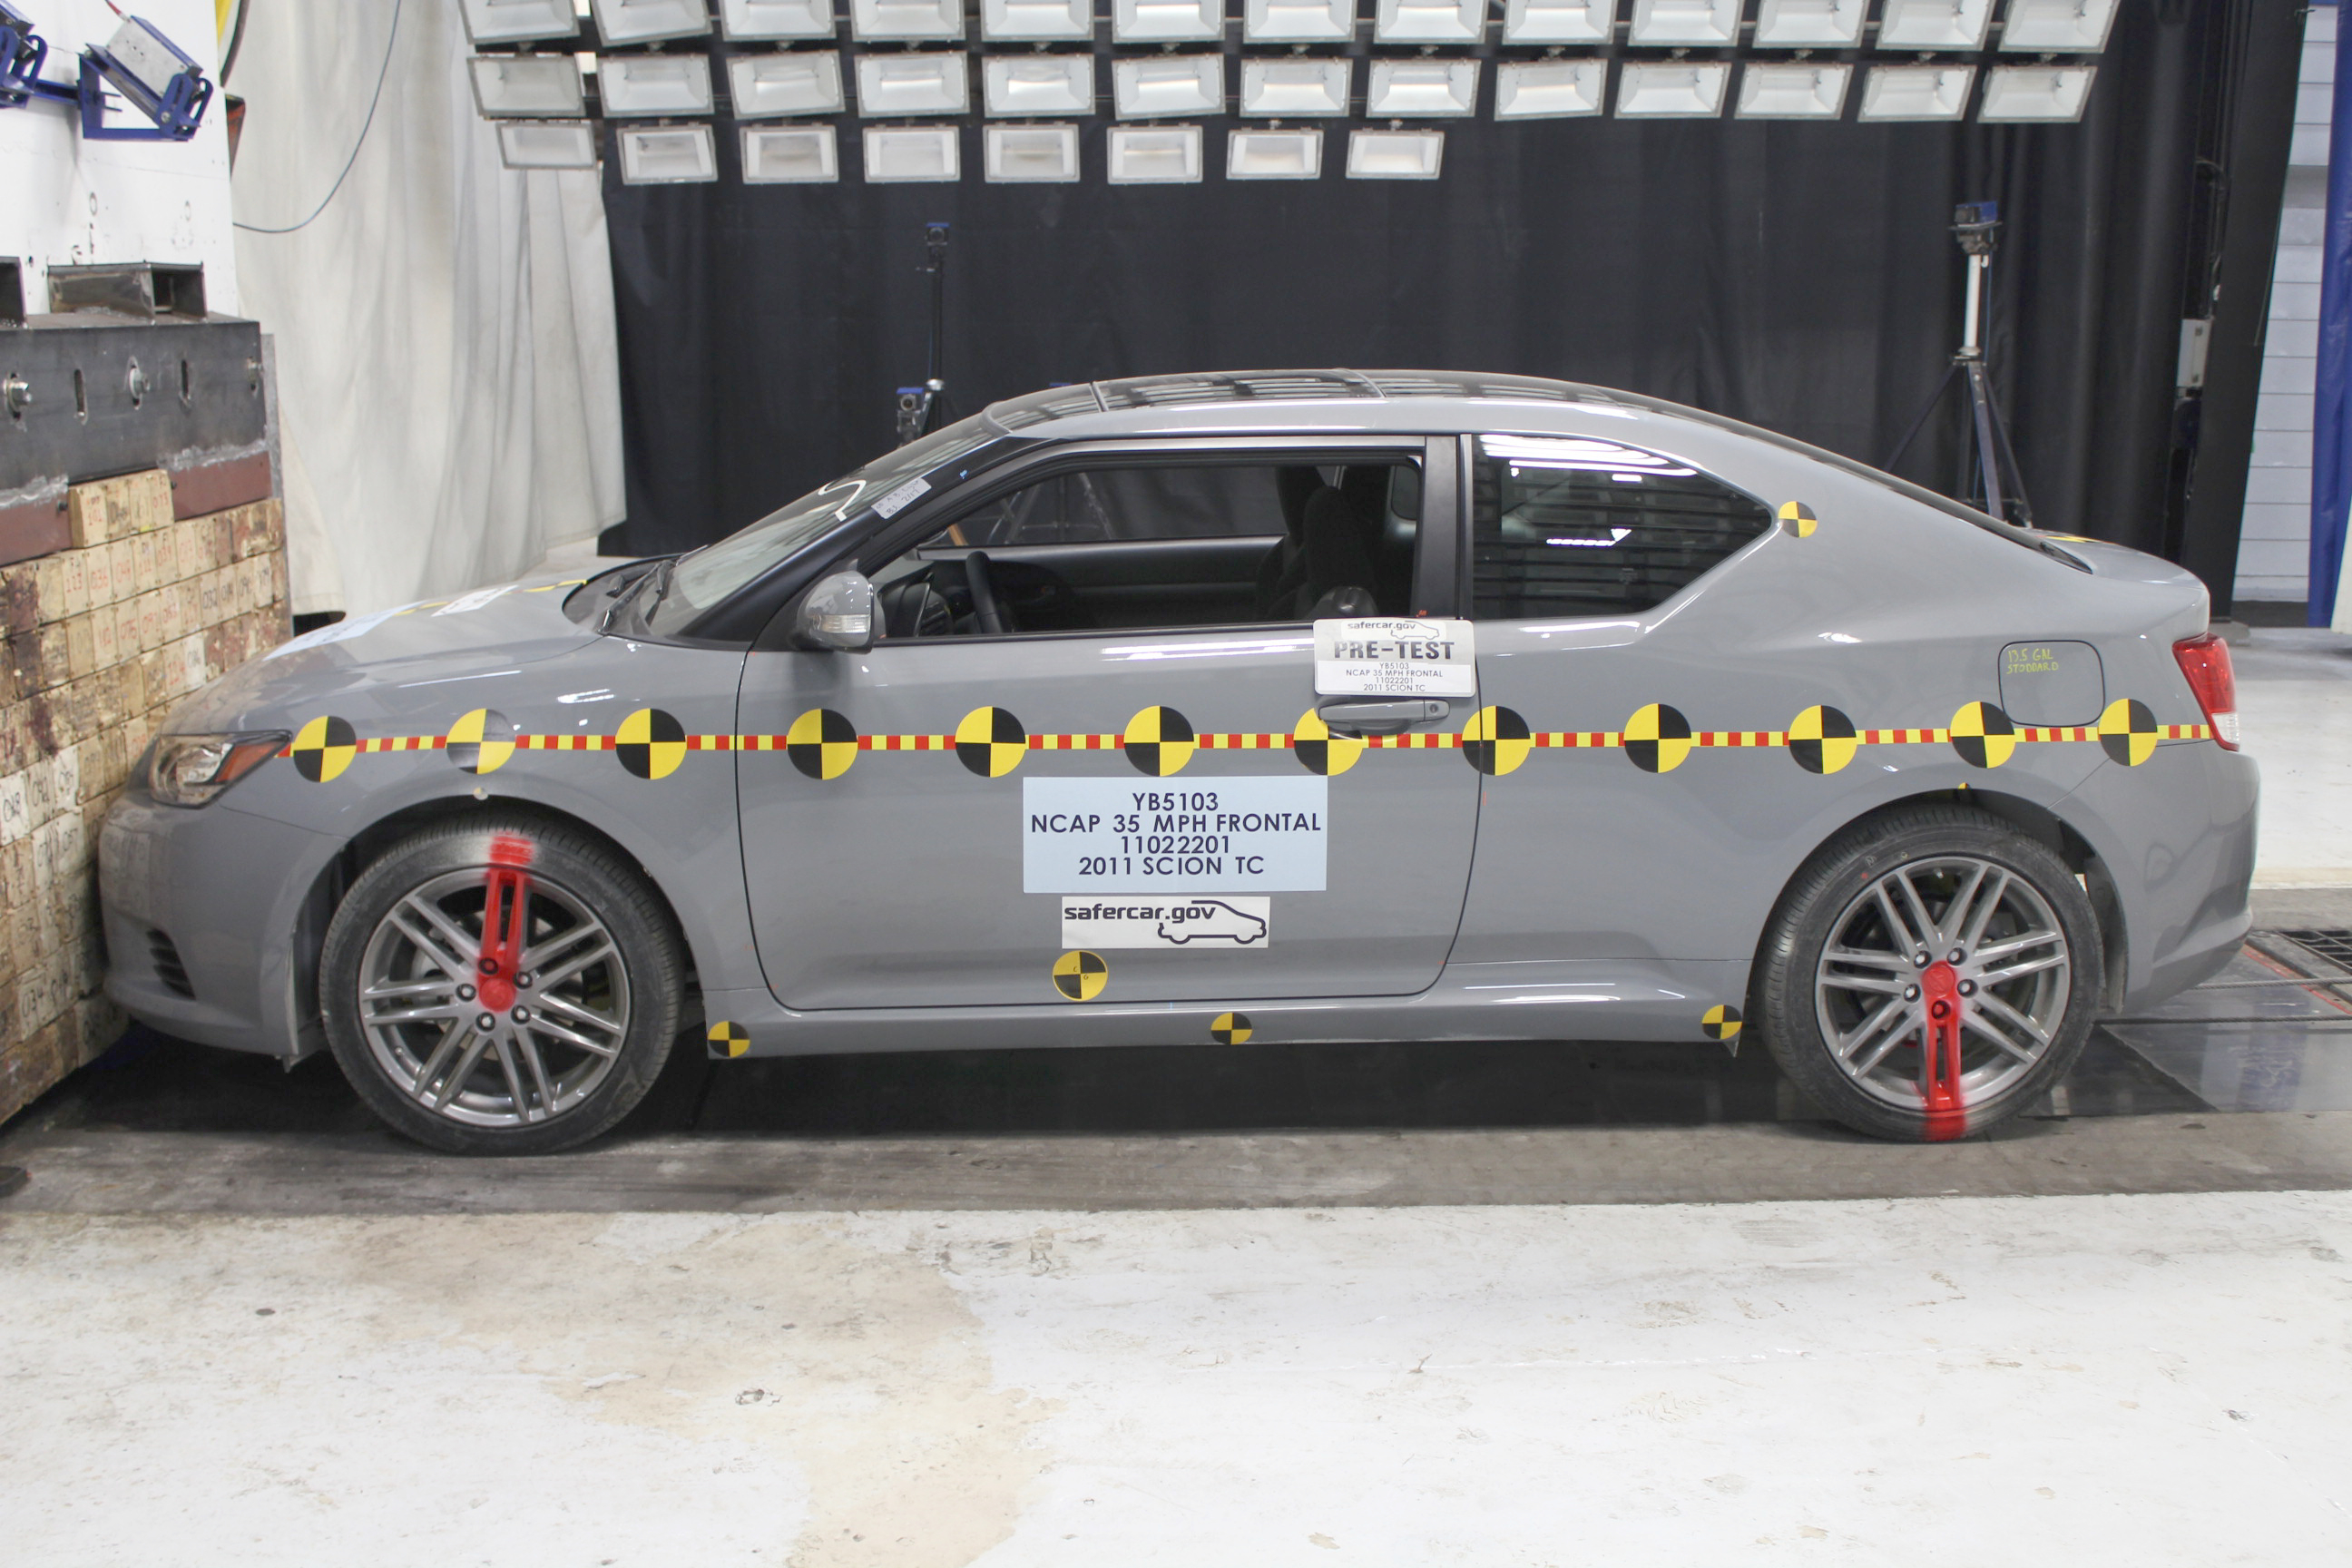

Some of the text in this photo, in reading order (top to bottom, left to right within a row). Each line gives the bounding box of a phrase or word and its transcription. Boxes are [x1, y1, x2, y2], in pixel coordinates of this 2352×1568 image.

[1348, 621, 1416, 631] safercar.gov
[1334, 641, 1455, 660] PRE-TEST
[2033, 648, 2053, 661] GAL
[1346, 669, 1370, 677] NCAP
[1385, 670, 1404, 678] MPH
[1406, 670, 1443, 678] FRONTAL
[1379, 662, 1409, 671] YB5103
[1364, 683, 1382, 691] 2011
[1376, 677, 1414, 685] 11022201
[1132, 792, 1219, 811] YB5103
[1032, 813, 1321, 833] NCAP 35 MPH FRONTAL
[1121, 836, 1229, 854] 11022201
[1079, 856, 1264, 876] 2011 SCION TC
[1064, 903, 1217, 924] safercar.gov
